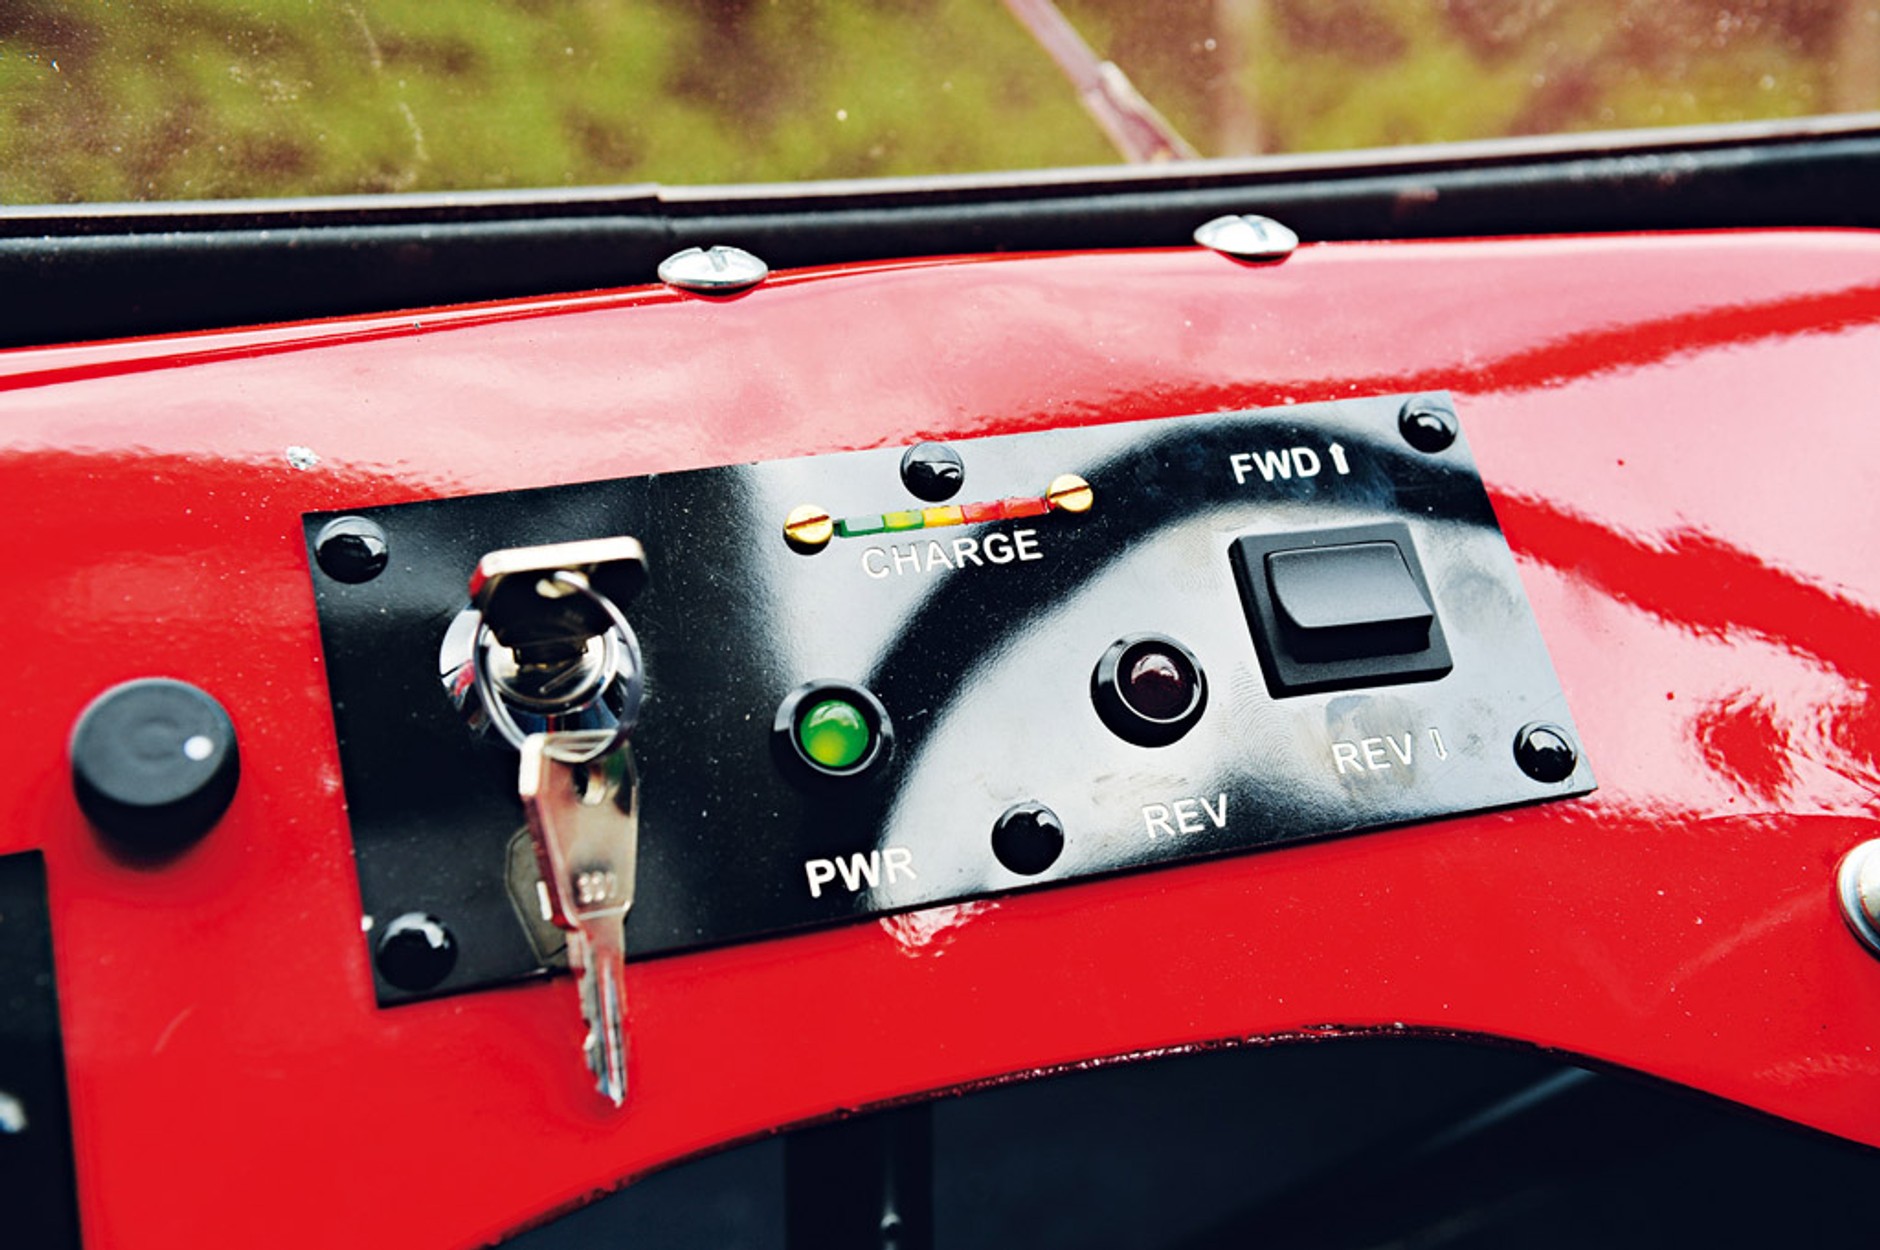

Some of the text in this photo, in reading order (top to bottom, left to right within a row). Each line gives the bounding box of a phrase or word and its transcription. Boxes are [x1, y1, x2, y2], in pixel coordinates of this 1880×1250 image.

[1229, 446, 1321, 485] FWD
[861, 528, 1044, 580] CHARGE
[1331, 731, 1412, 774] REV
[1141, 793, 1227, 839] REV
[805, 847, 917, 898] PWR
